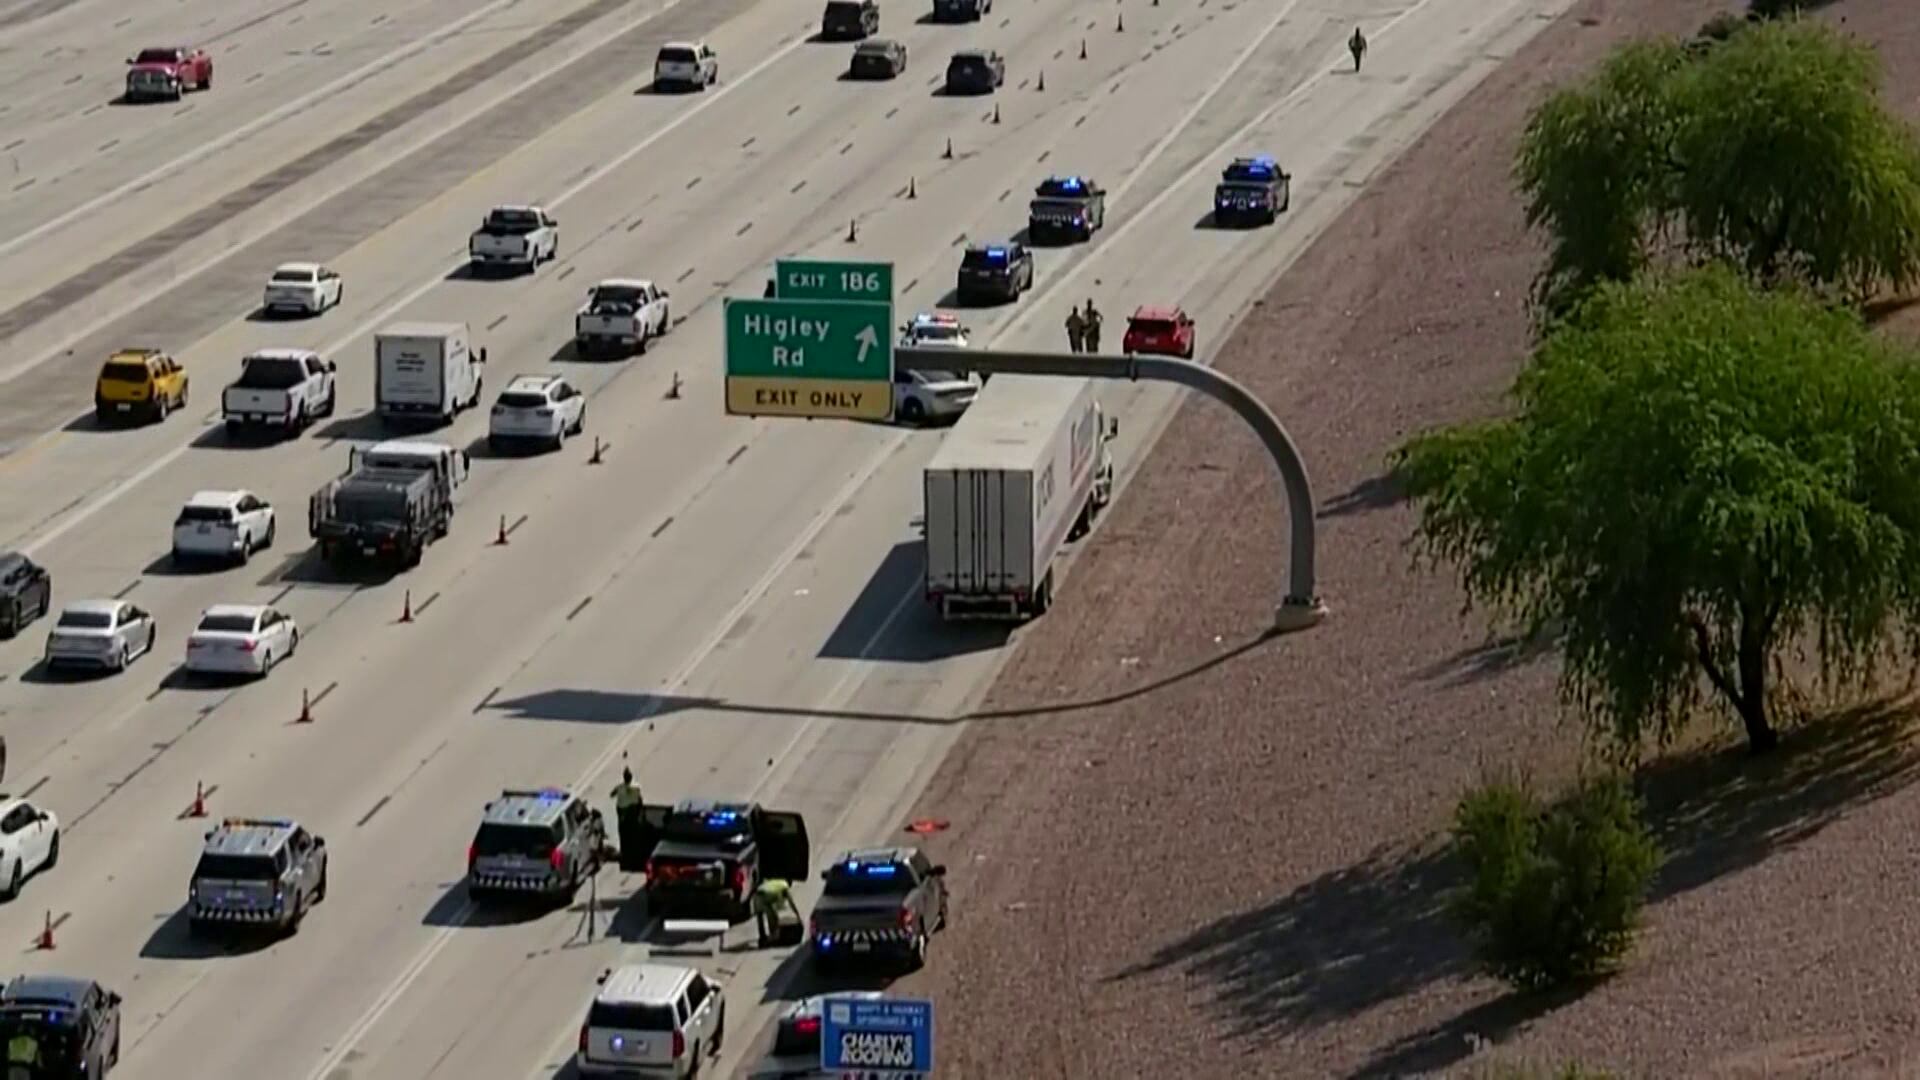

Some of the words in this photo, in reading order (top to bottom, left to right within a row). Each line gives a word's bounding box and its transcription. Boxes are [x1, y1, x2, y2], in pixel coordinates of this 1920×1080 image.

[789, 272, 826, 288] EXIT
[840, 271, 881, 292] 186
[744, 314, 830, 342] Higley
[773, 346, 804, 367] Rd
[756, 389, 799, 405] EXIT
[810, 391, 863, 408] ONLY
